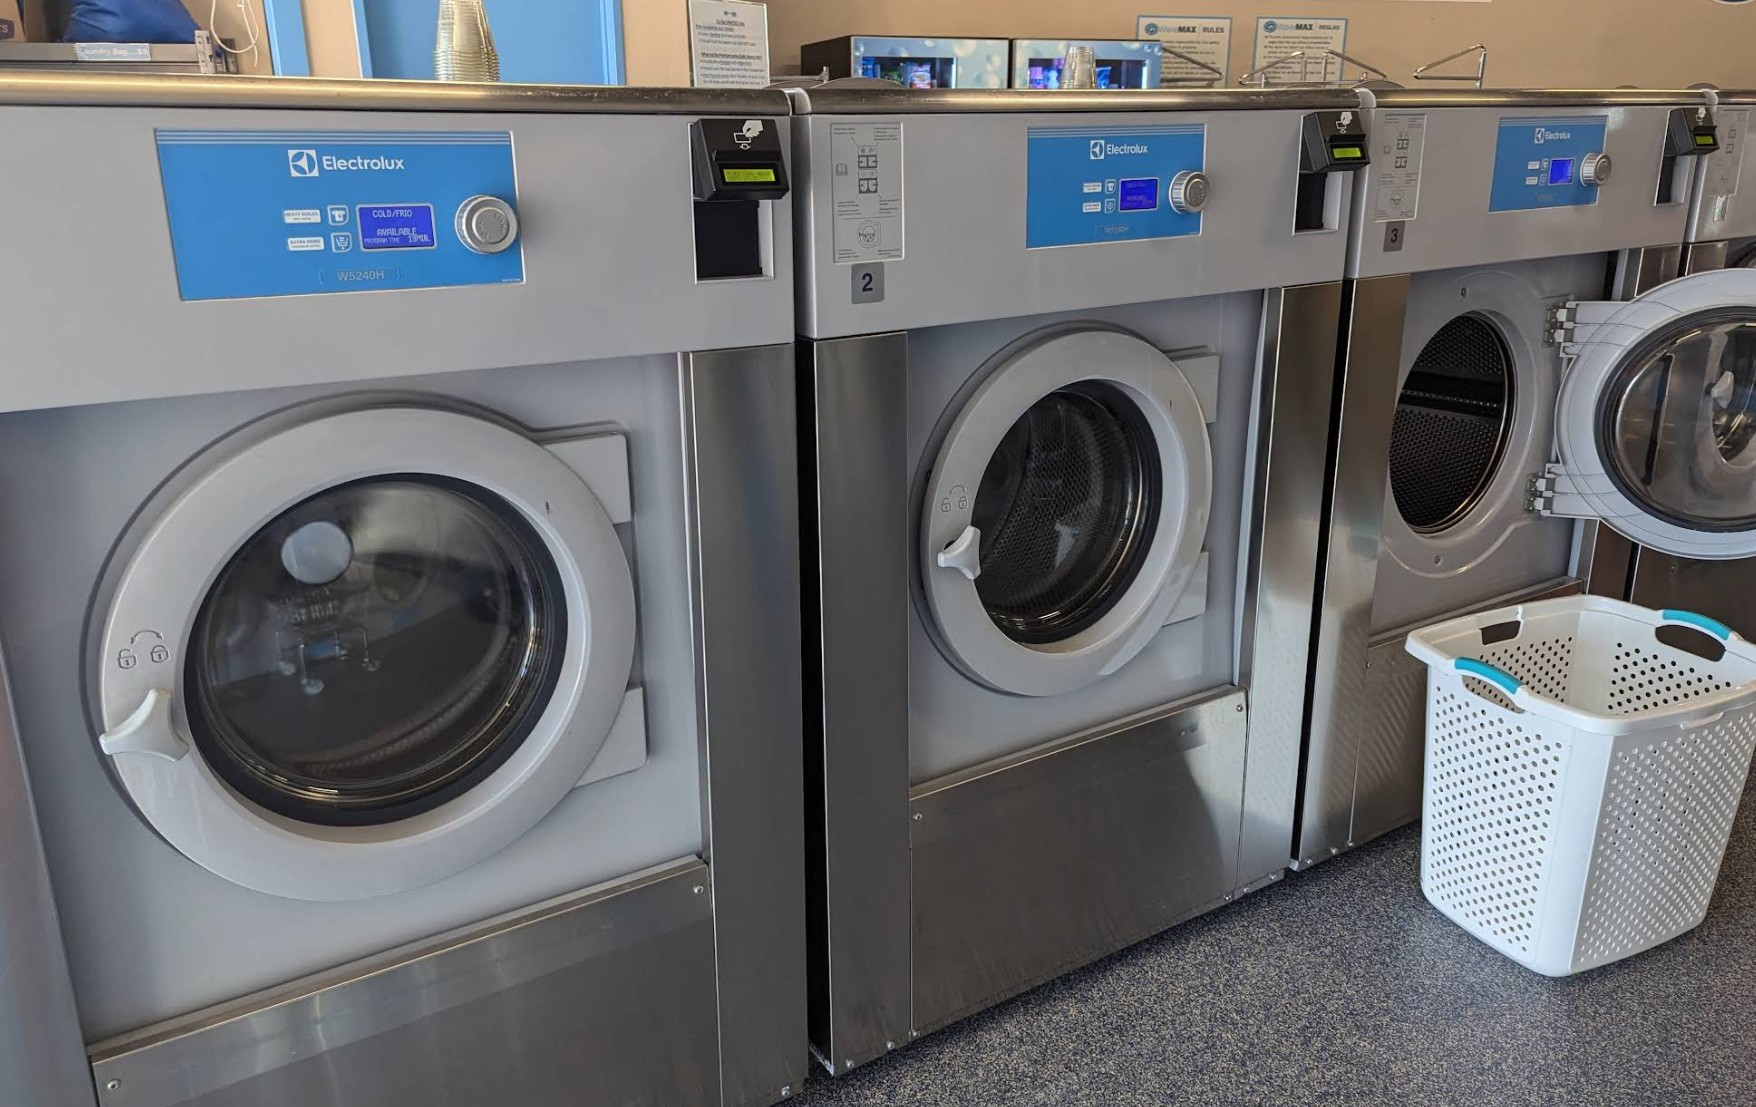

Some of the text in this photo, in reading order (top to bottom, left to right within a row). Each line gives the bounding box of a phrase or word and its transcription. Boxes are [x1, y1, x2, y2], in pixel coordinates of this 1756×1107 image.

[1159, 25, 1225, 34] WaveMAX RULES
[1544, 131, 1571, 141] Electrolux
[1106, 143, 1148, 155] Electrolux
[322, 154, 405, 172] Electrolux
[372, 209, 413, 218] COLD/FRIO
[377, 227, 417, 237] AVAILABLE
[1390, 228, 1398, 243] 3
[336, 268, 385, 282] W5240H
[861, 272, 873, 293] 2
